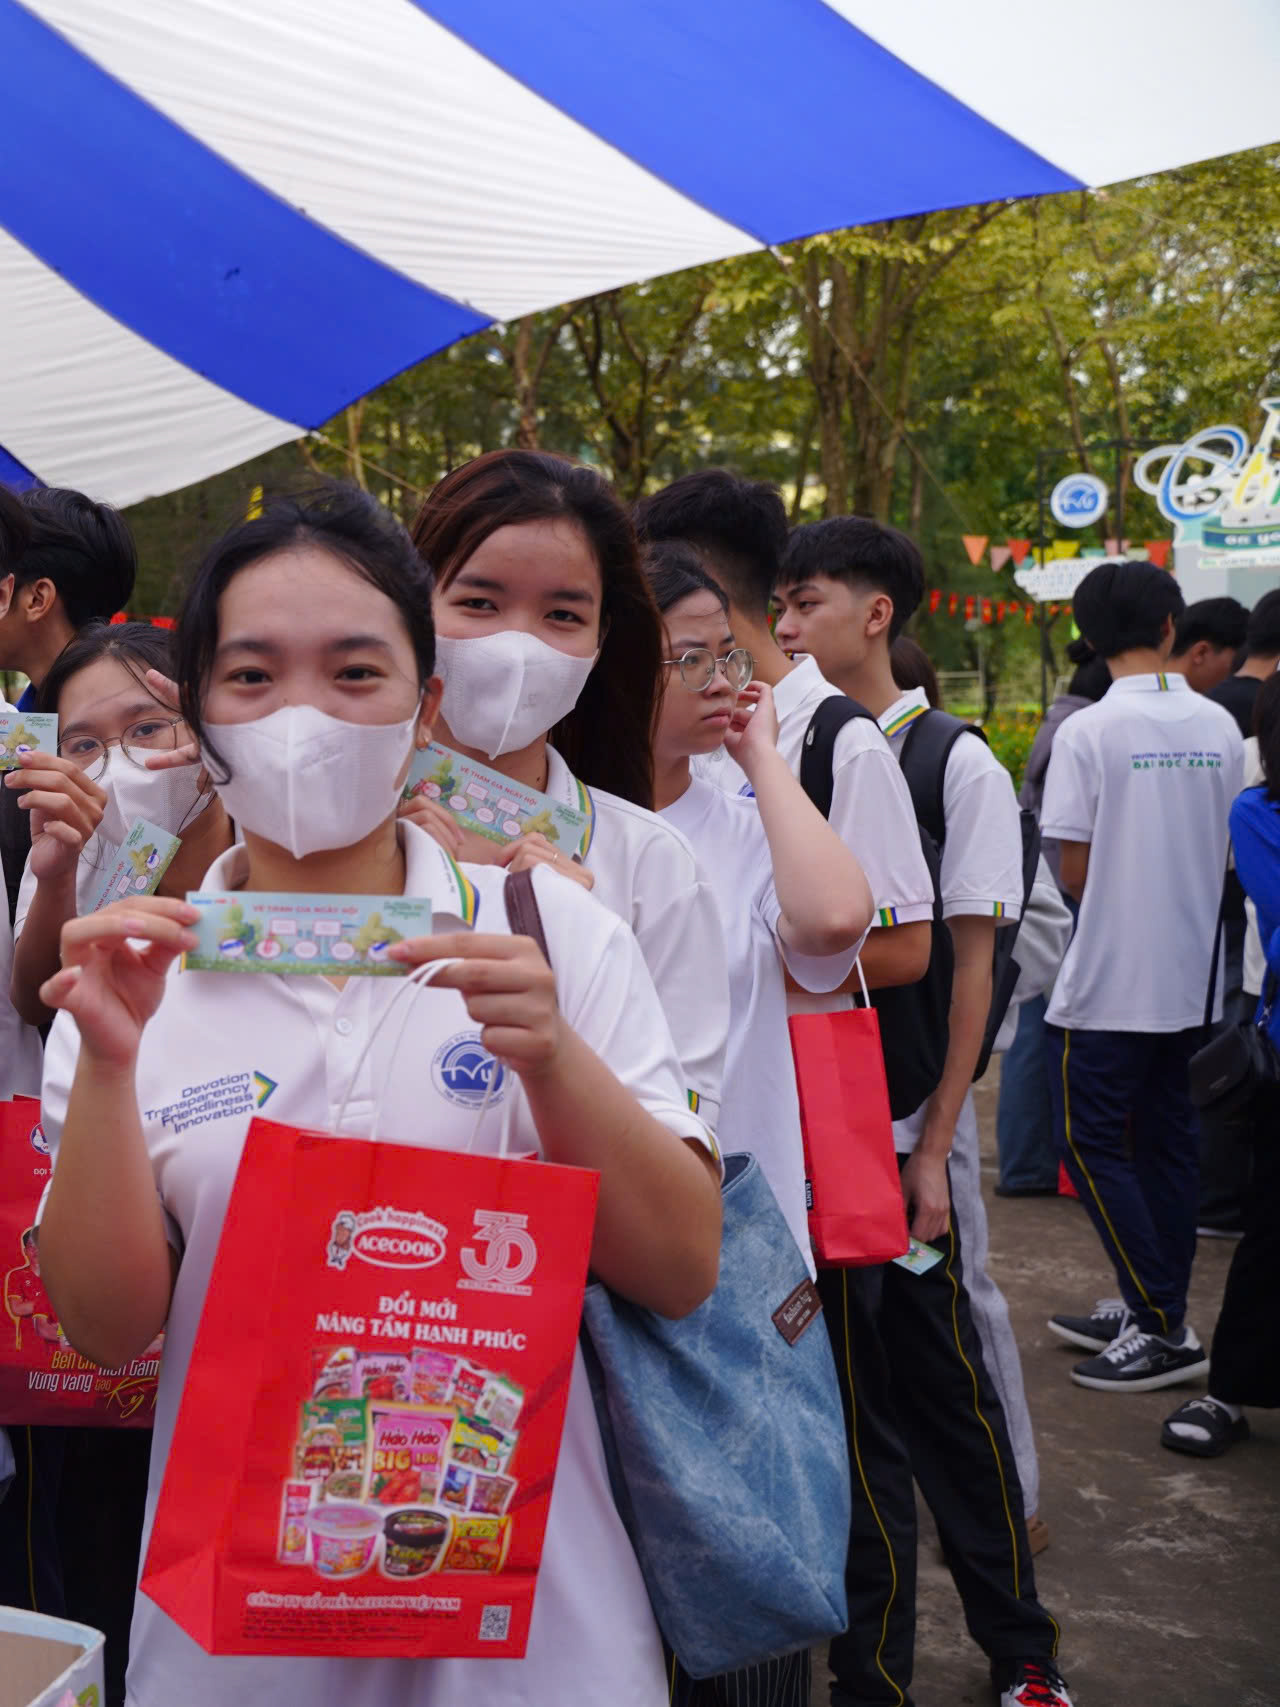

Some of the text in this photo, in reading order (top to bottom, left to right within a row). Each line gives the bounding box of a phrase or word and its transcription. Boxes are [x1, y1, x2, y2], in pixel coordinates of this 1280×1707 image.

[1187, 760, 1223, 769] XANH
[181, 1072, 250, 1099] Devotion
[144, 1083, 250, 1121] Transparency
[161, 1093, 254, 1128] Friendliness
[174, 1103, 254, 1134] Innovation
[378, 1290, 458, 1321] ĐỔI MỚI
[315, 1312, 365, 1335] NÂNG
[415, 1322, 468, 1345] HẠNH
[472, 1329, 527, 1351] PHÚC
[379, 1427, 441, 1446] Hảo Hảo
[375, 1449, 412, 1473] BIG
